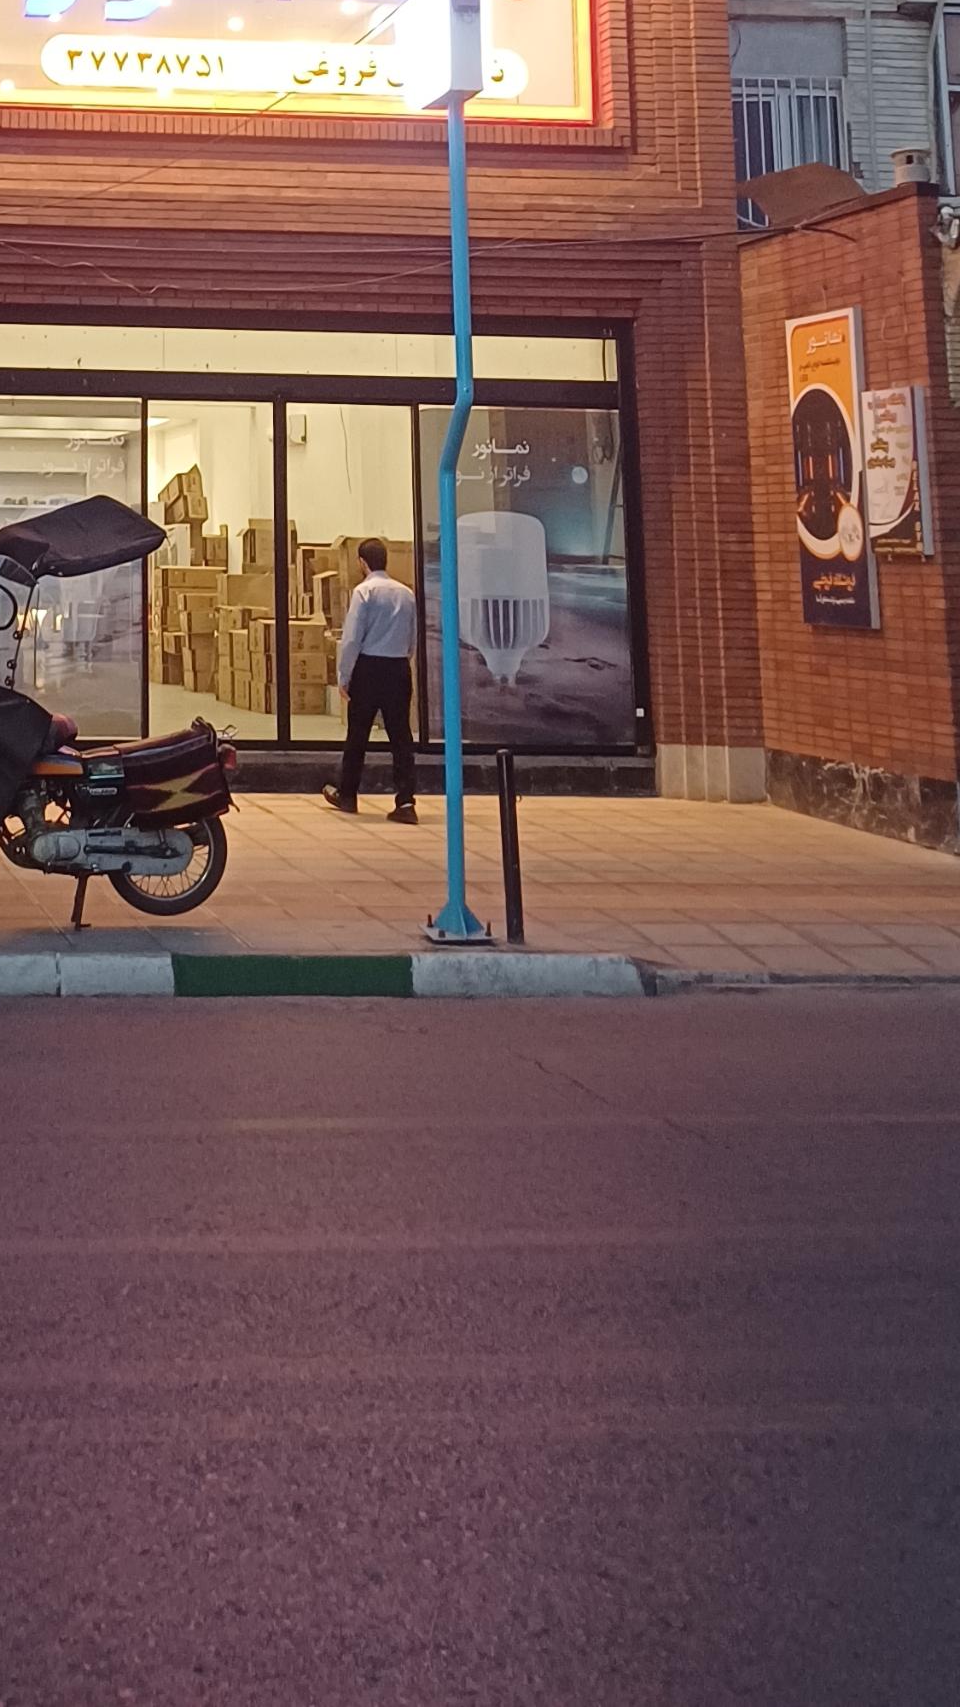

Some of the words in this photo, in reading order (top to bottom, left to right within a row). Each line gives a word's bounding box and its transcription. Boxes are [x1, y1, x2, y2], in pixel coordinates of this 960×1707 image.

[471, 437, 531, 460] نمانور
[455, 465, 485, 487] نو
[499, 464, 532, 487] فراتر
